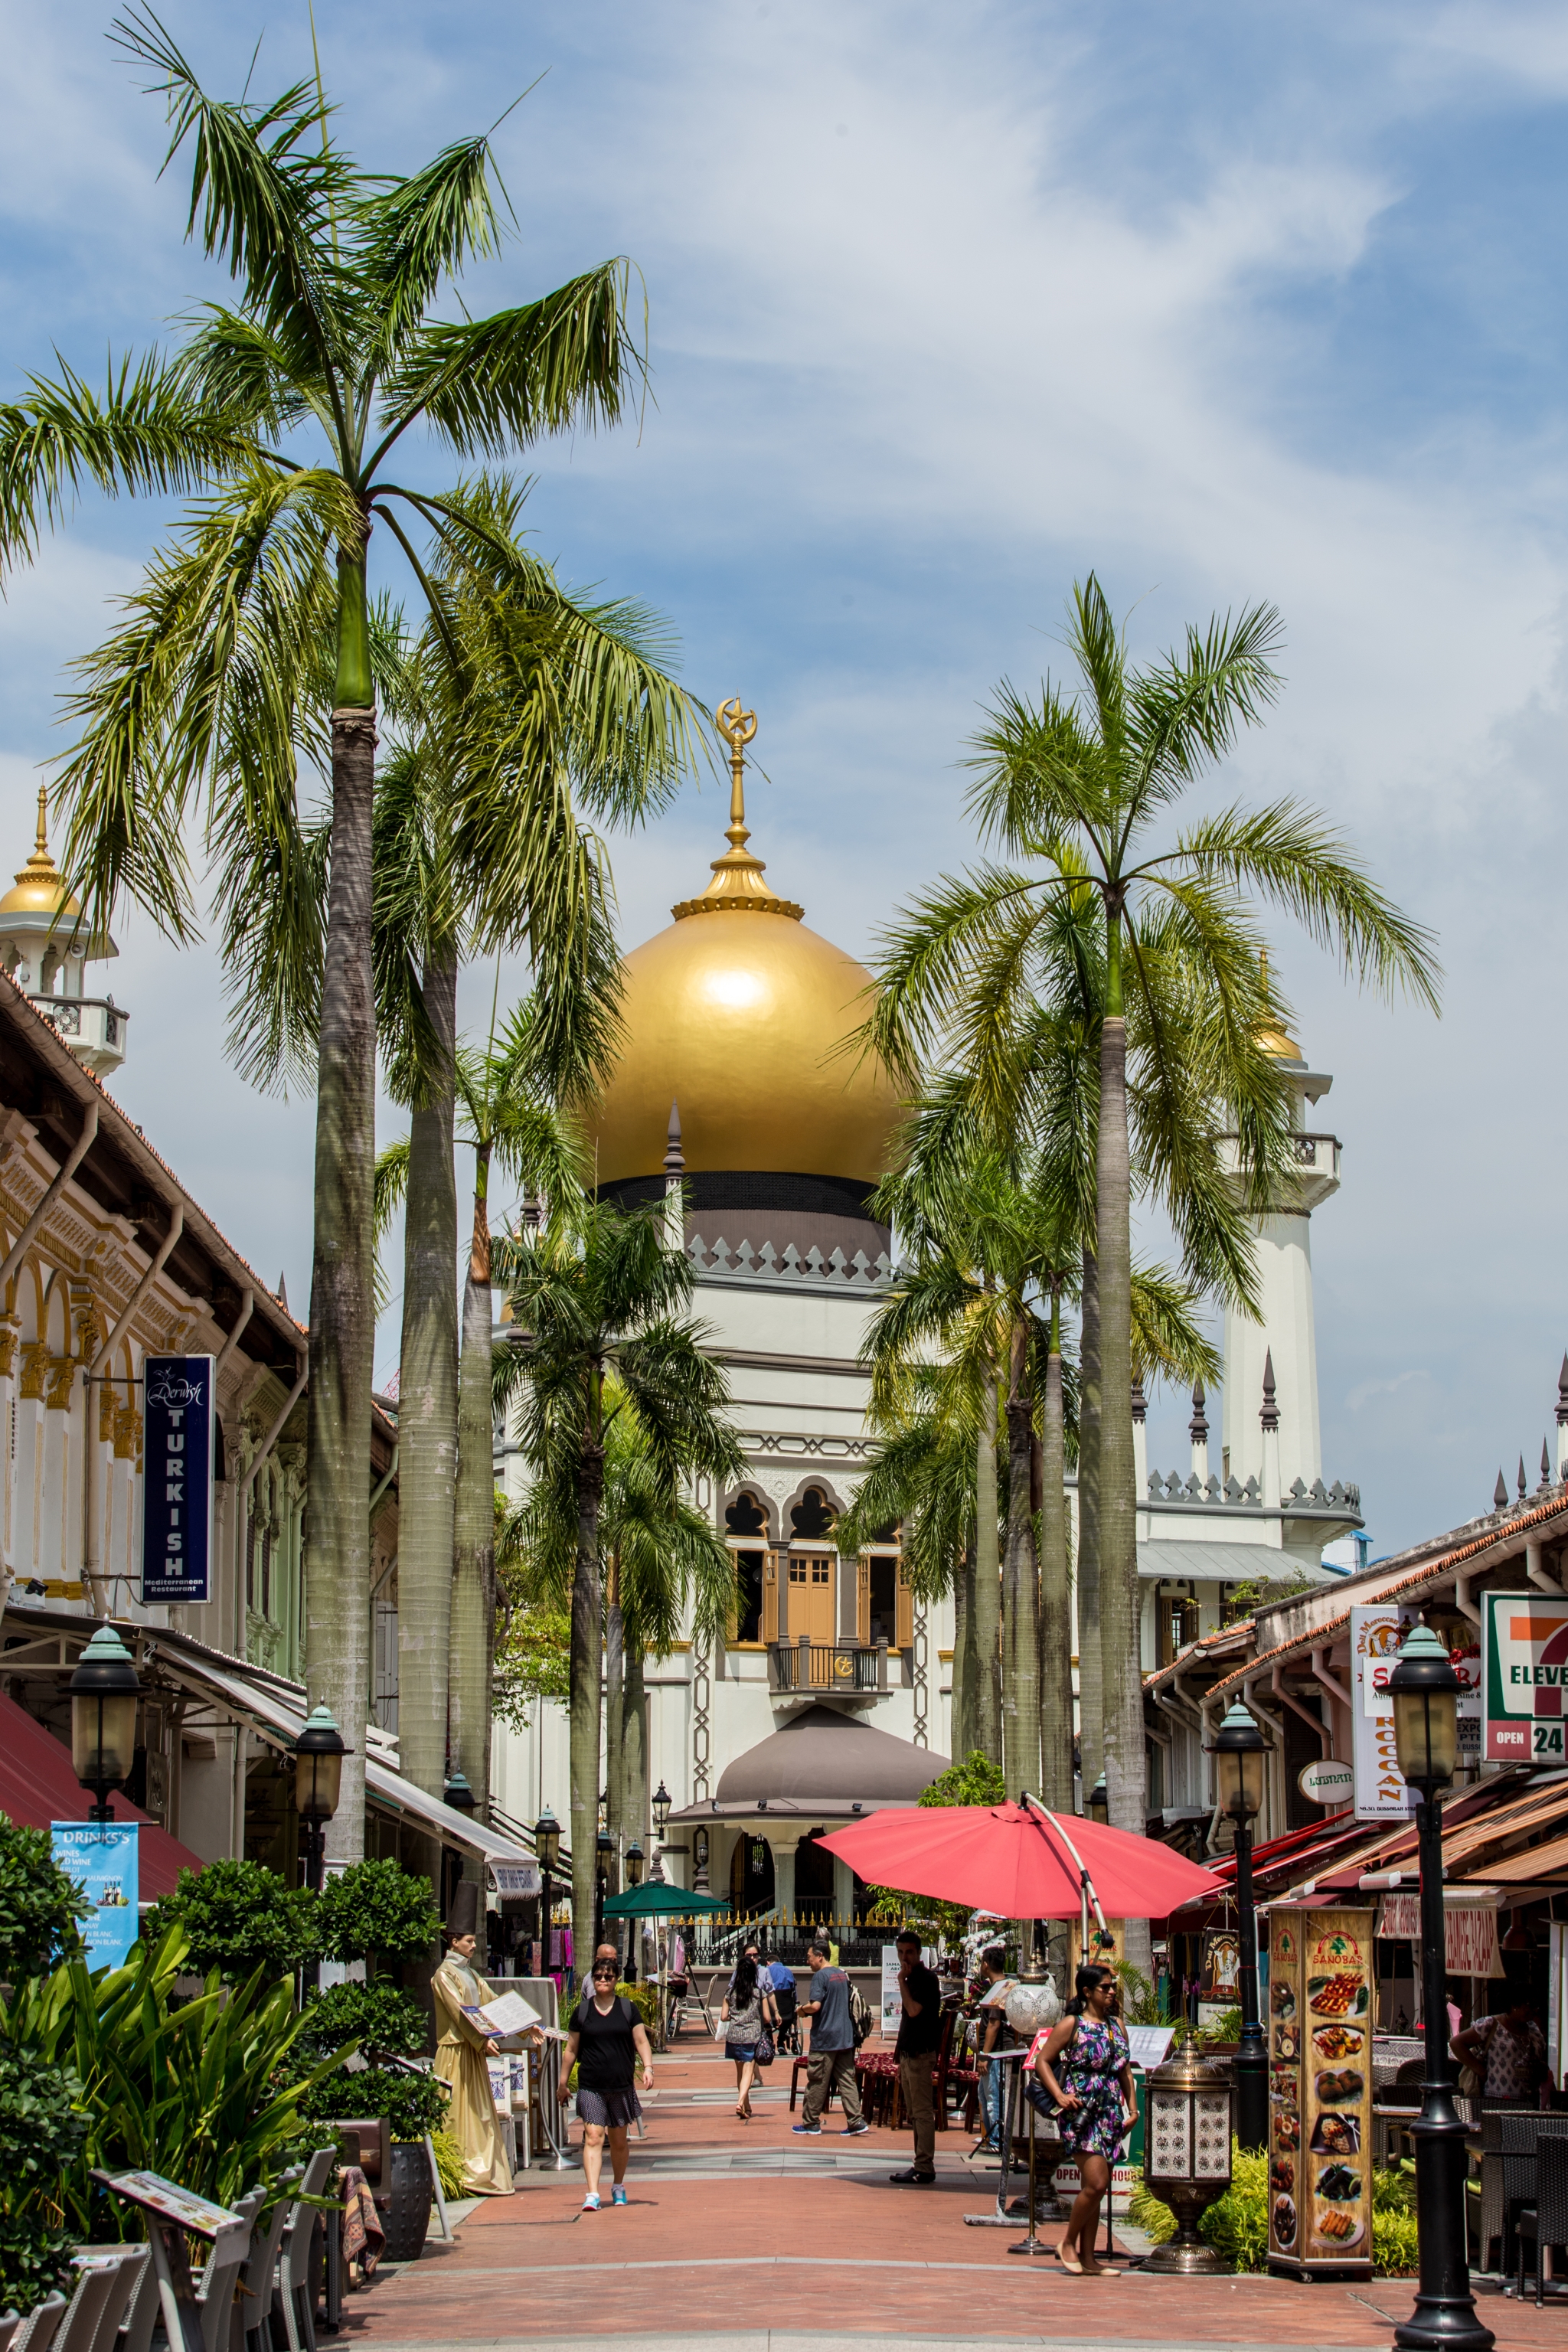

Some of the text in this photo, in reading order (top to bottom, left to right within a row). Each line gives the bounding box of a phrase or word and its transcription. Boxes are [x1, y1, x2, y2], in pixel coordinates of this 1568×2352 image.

[148, 1379, 204, 1408] Derwish
[165, 1410, 184, 1575] TURKISH
[1357, 1616, 1399, 1655] Deli Moroccan
[1511, 1665, 1568, 1685] ELEVE
[1496, 1727, 1563, 1753] OPEN 24
[1309, 1773, 1352, 1786] LUBNAN
[1273, 1953, 1298, 1963] SANOBAR
[1312, 1954, 1364, 1965] SANOBAR
[1057, 2169, 1080, 2180] OPEN
